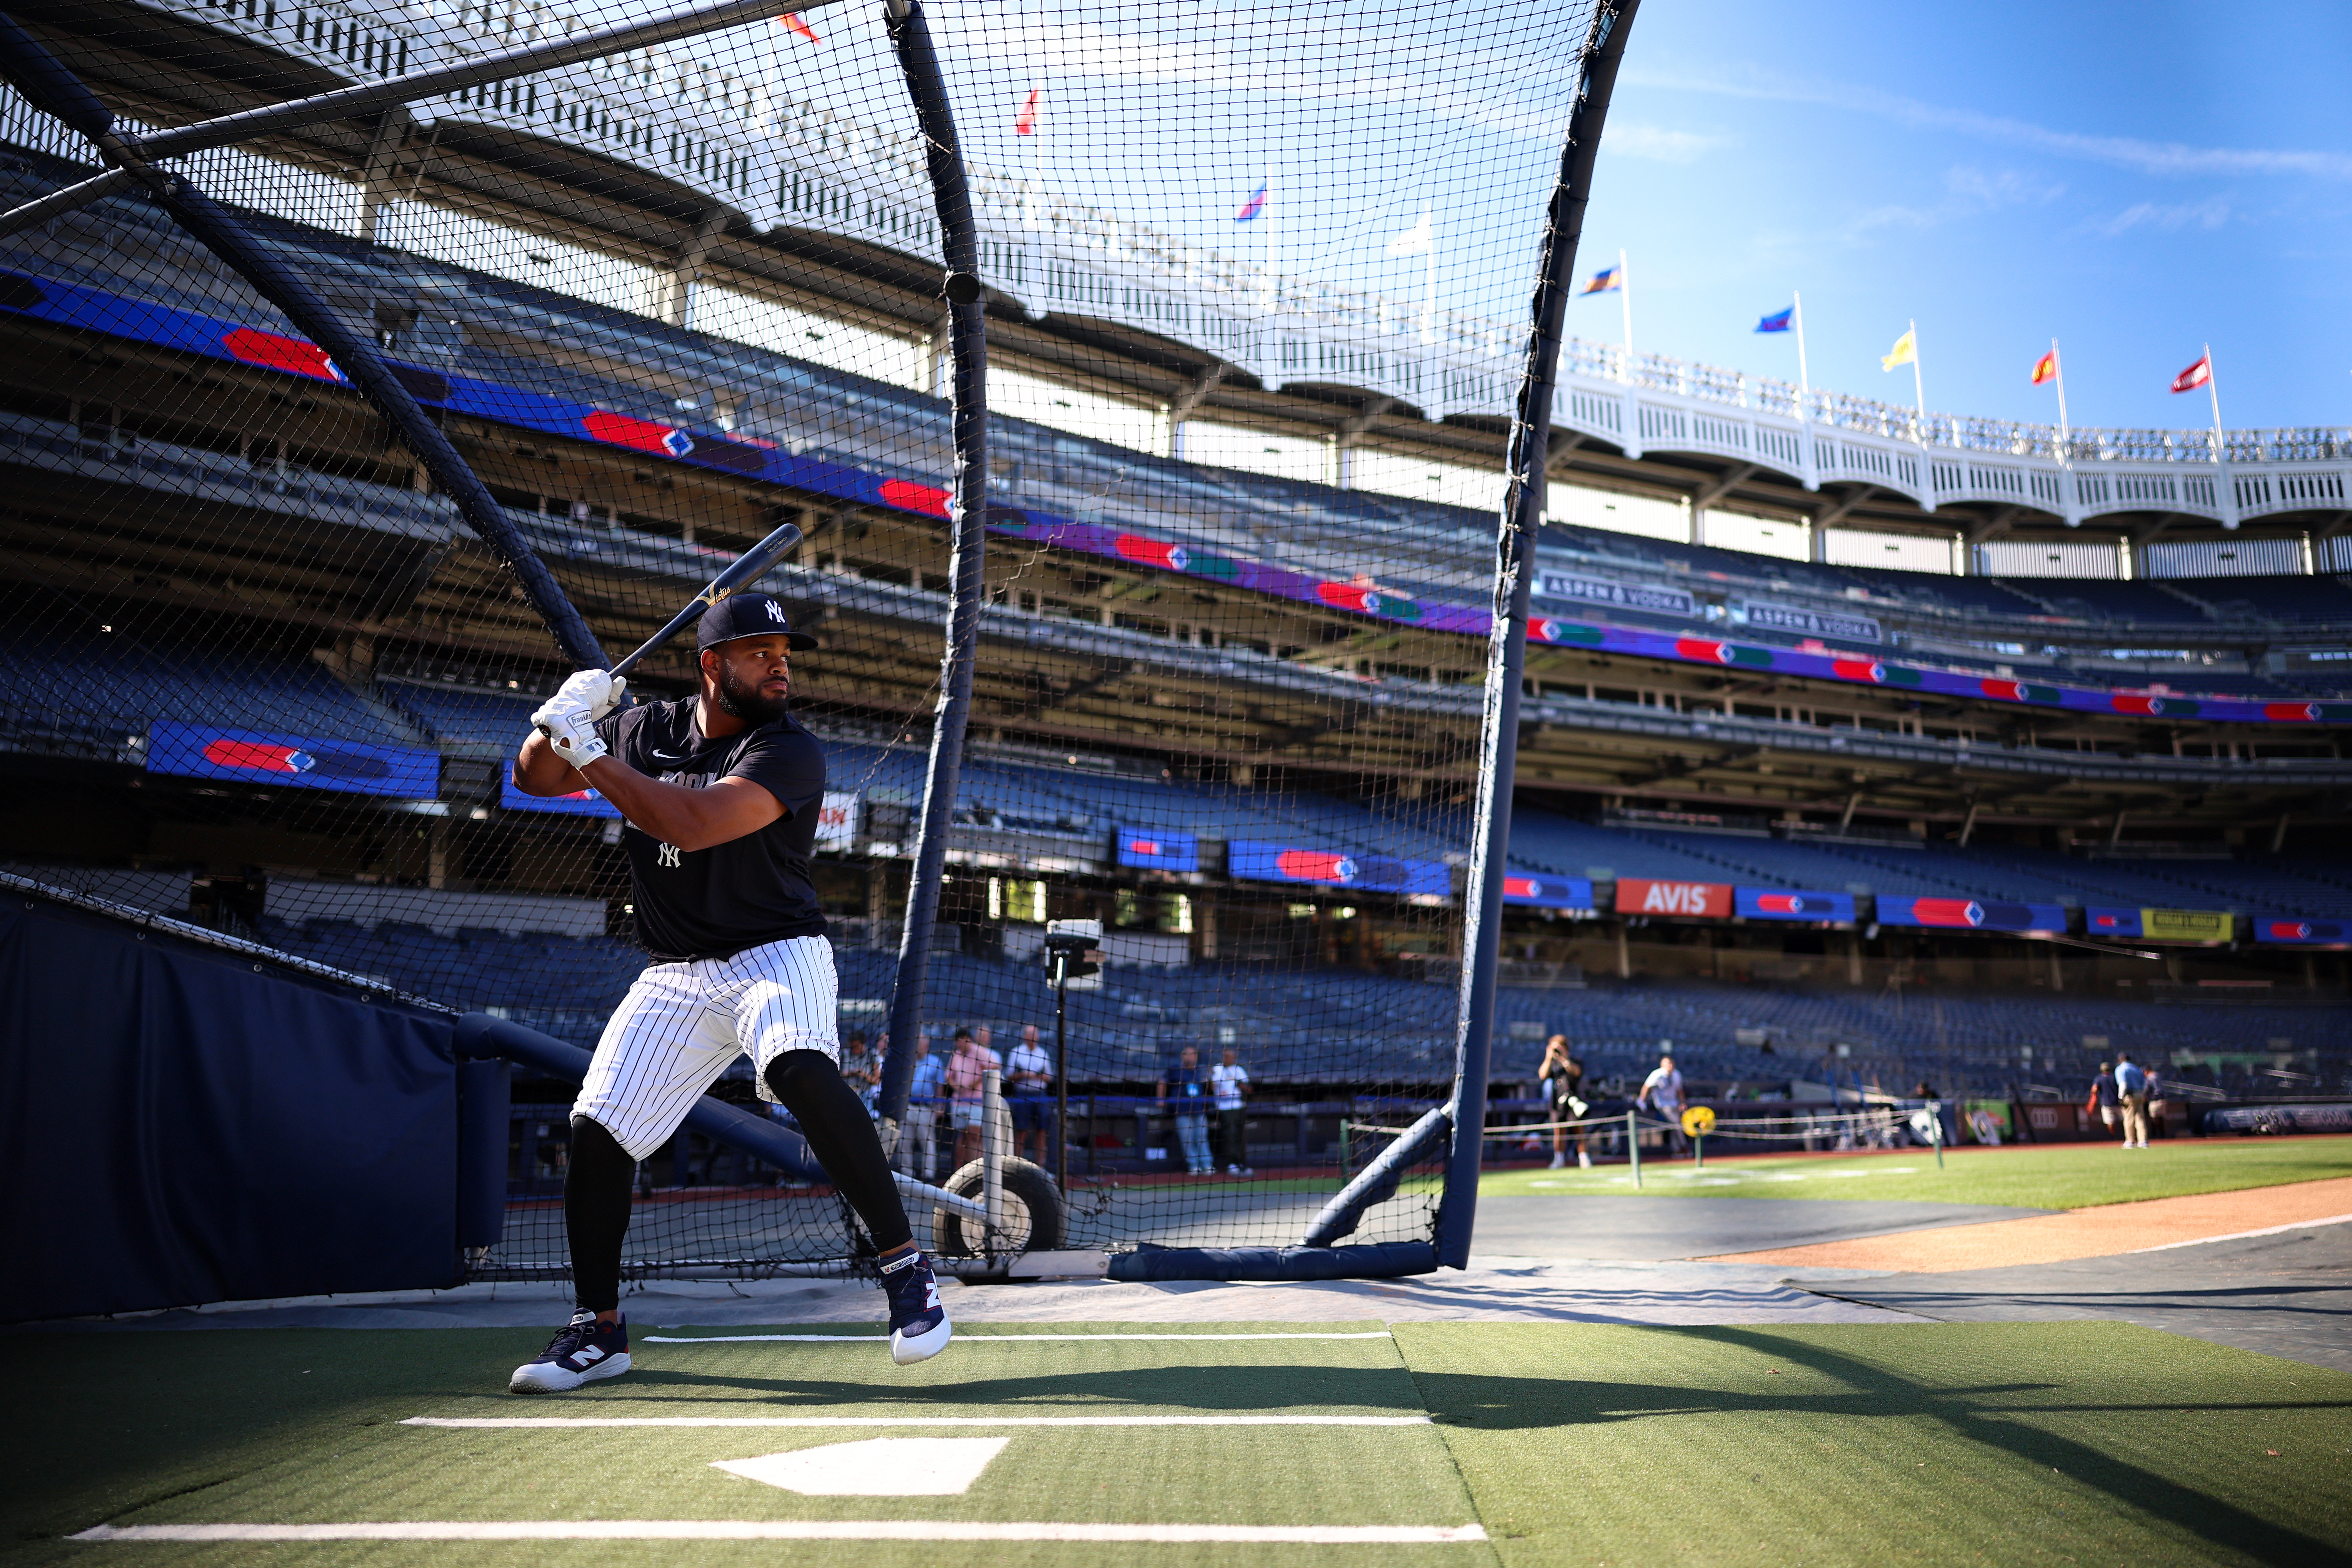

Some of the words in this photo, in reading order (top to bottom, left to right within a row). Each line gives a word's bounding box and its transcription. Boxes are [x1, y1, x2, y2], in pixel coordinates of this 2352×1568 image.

[767, 544, 778, 553] HELIOT
[777, 536, 788, 545] RAMOS
[693, 580, 731, 607] Victus
[1549, 577, 1609, 599] ASPEN
[1627, 589, 1686, 611] VODKA
[765, 599, 785, 623] NY
[1753, 608, 1806, 628] ASPEN
[1822, 619, 1872, 637] VODKA
[571, 713, 591, 726] Franklin
[657, 842, 681, 868] NY
[1643, 883, 1707, 915] AVIS
[900, 1257, 914, 1266] 3000v7
